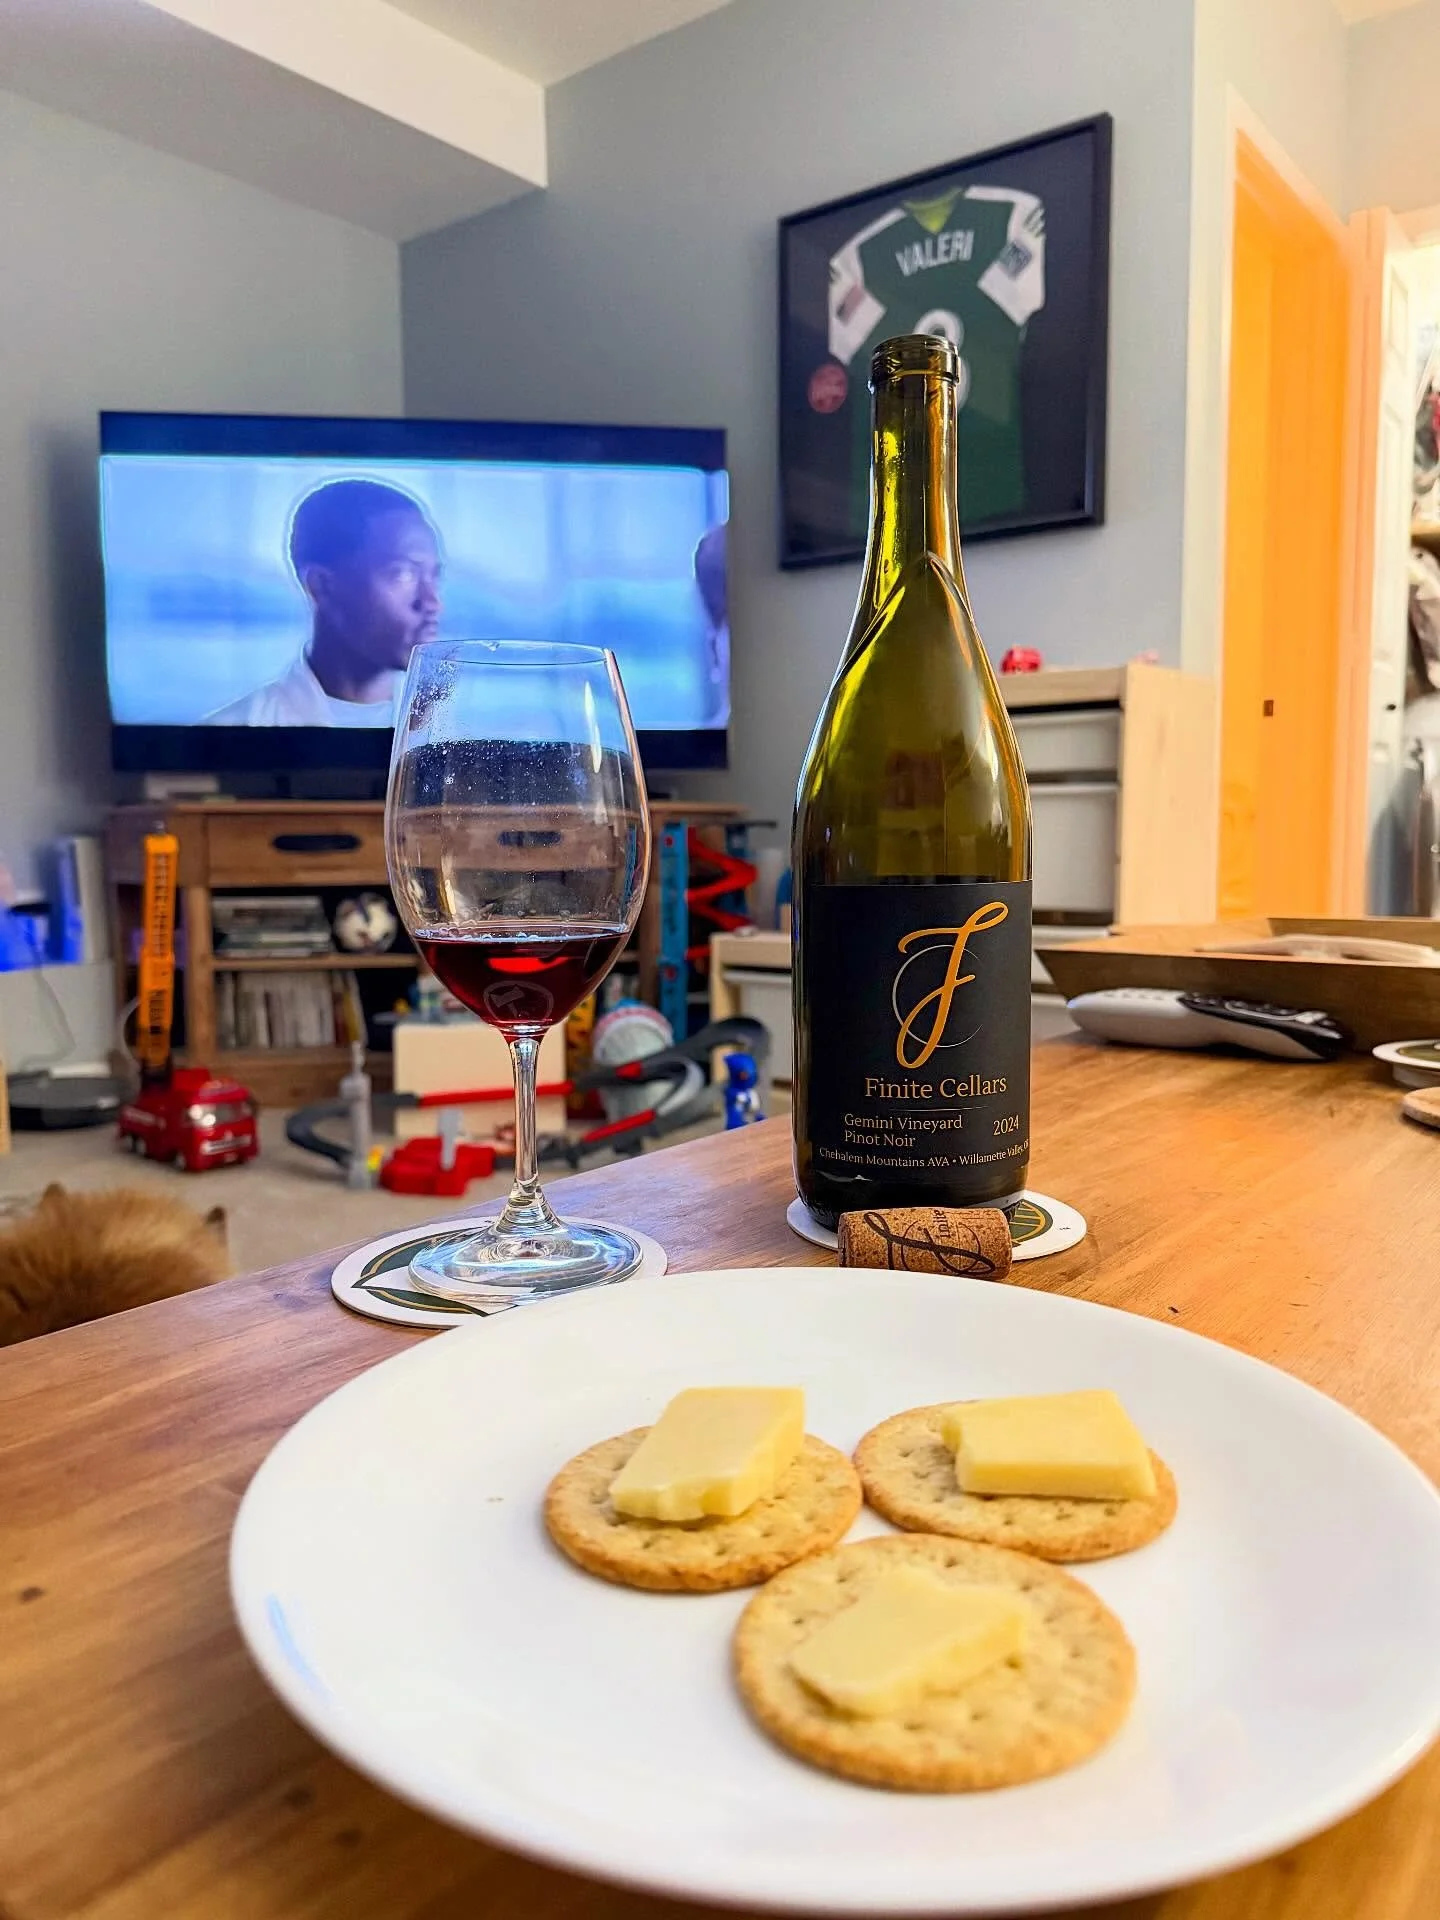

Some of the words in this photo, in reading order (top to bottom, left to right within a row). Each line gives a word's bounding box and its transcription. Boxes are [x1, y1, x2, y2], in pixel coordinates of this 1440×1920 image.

[895, 229, 975, 277] VALERI
[864, 1077, 933, 1099] Finite
[939, 1074, 1008, 1098] Cellars
[844, 1113, 893, 1129] Gemini
[897, 1114, 964, 1134] Vineyard
[993, 1114, 1019, 1136] 2024
[844, 1129, 881, 1146] Pinot
[883, 1133, 916, 1147] Noir
[819, 1147, 863, 1164] Chehalem
[866, 1154, 925, 1167] Mountains
[927, 1156, 950, 1167] AVA
[959, 1151, 1007, 1166] Willamette
